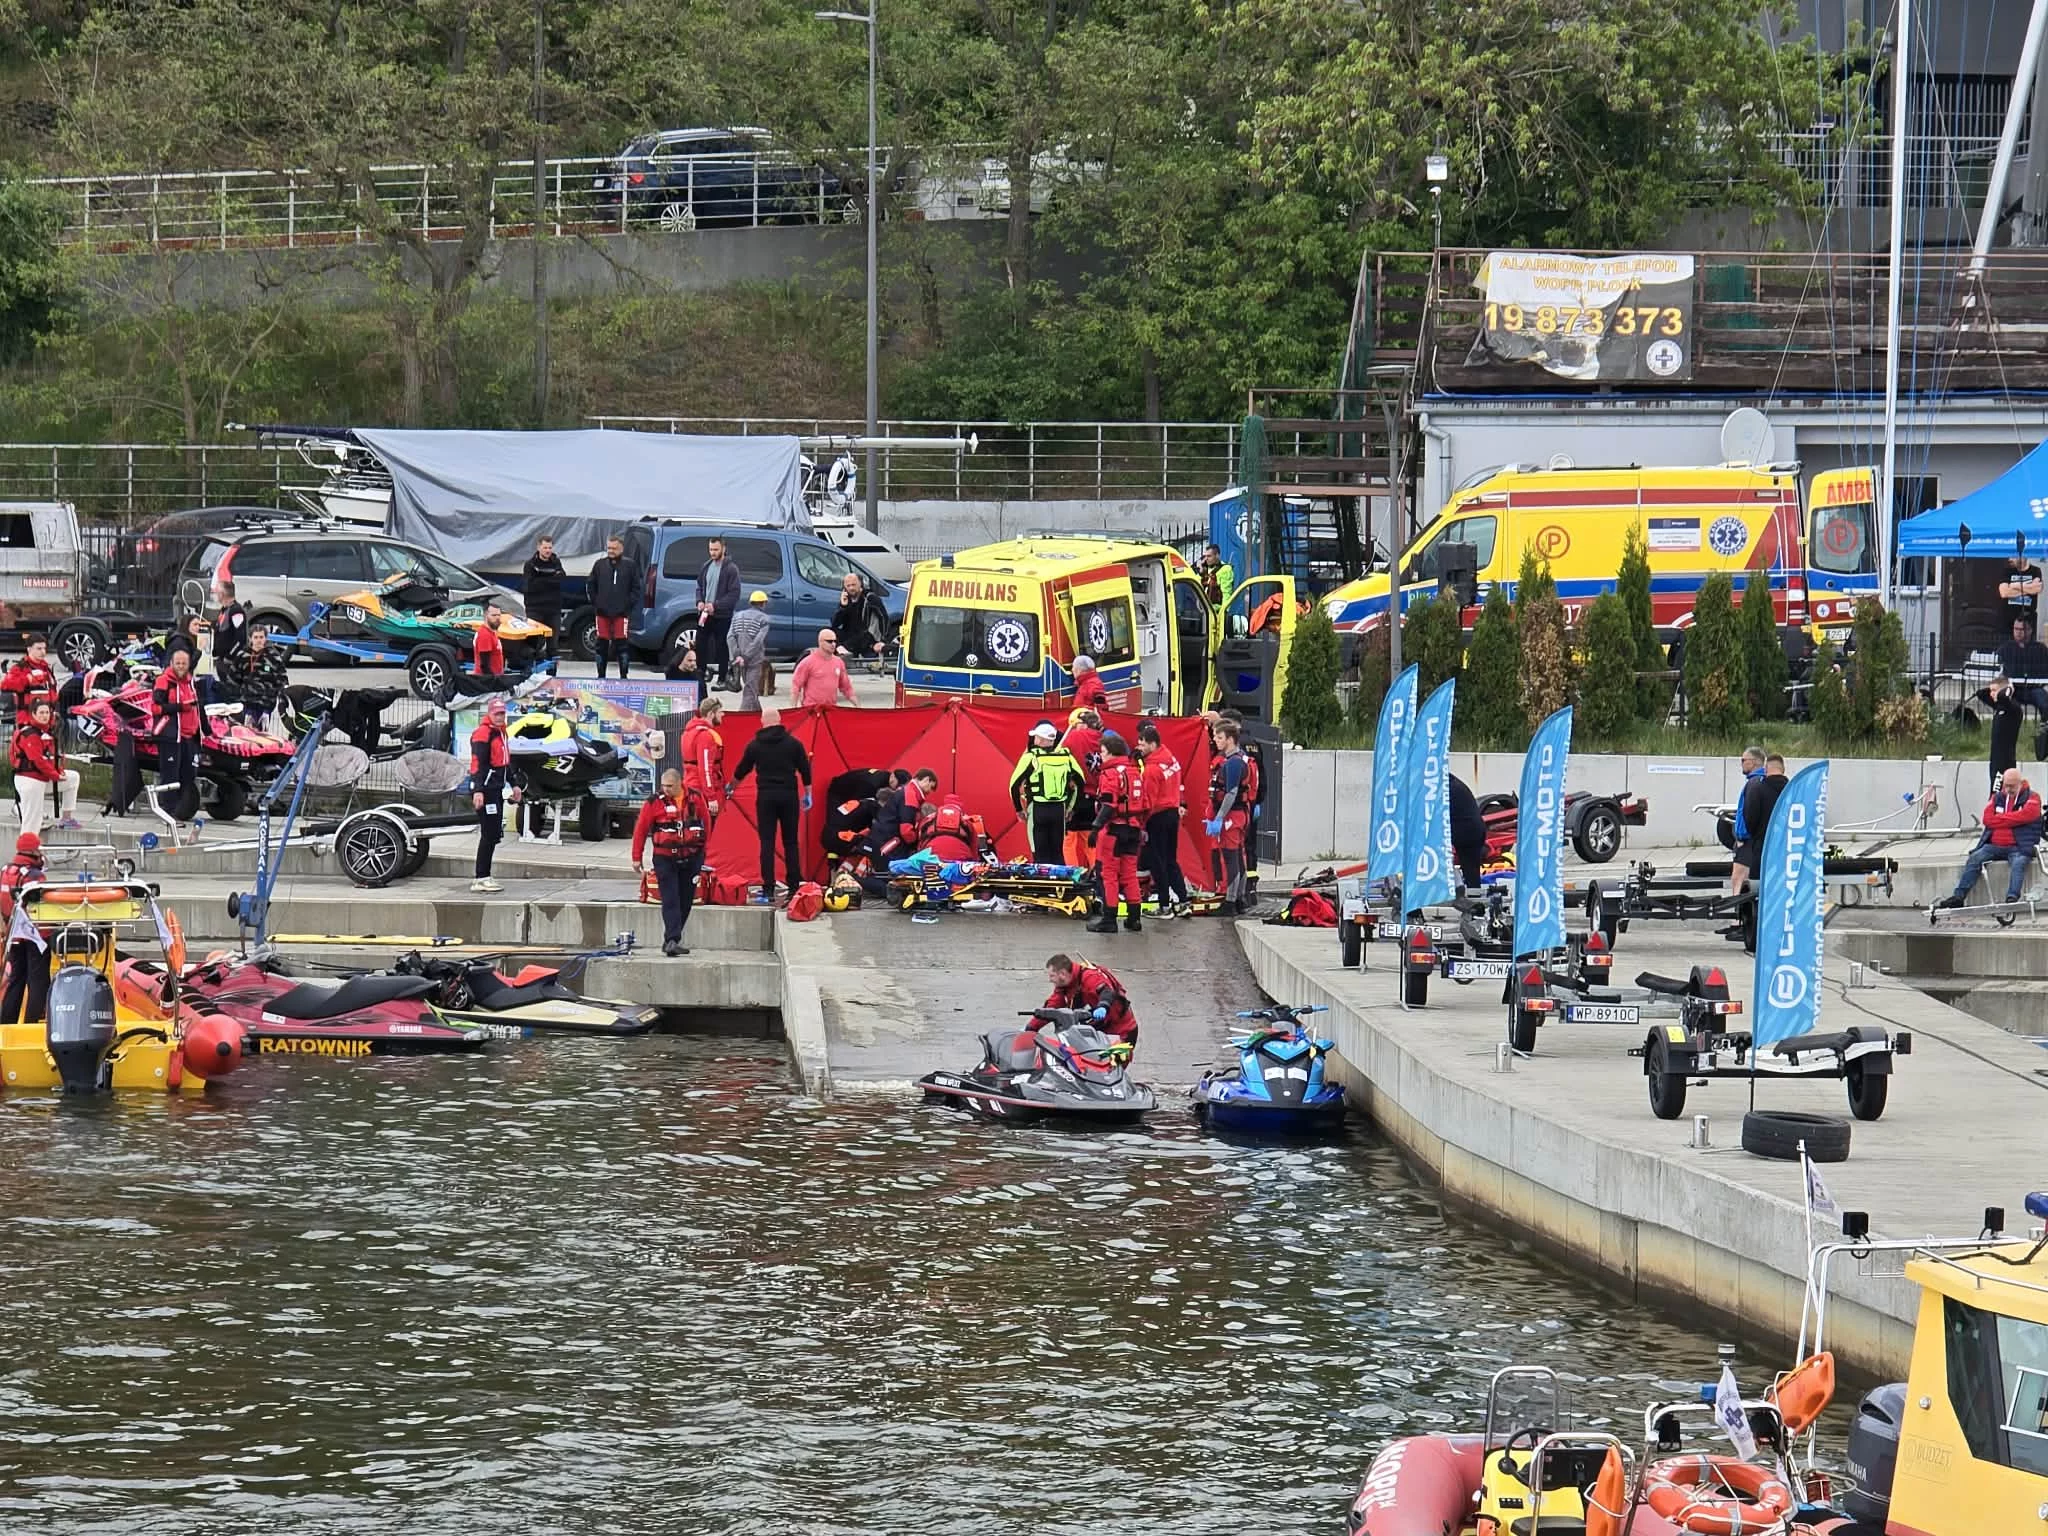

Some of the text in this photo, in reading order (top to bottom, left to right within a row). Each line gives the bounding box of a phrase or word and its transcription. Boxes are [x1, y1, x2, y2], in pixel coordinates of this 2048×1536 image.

[1500, 257, 1678, 275] ALARMOWY TELEFON
[1533, 276, 1583, 290] WOPR
[1485, 303, 1684, 336] 19 873 373
[23, 578, 65, 589] REMONDIS
[928, 579, 1018, 603] AMBULANS
[1814, 865, 1825, 916] more
[1456, 963, 1472, 975] ZS
[1576, 1008, 1592, 1020] WP
[259, 1038, 373, 1055] RATOWNIK
